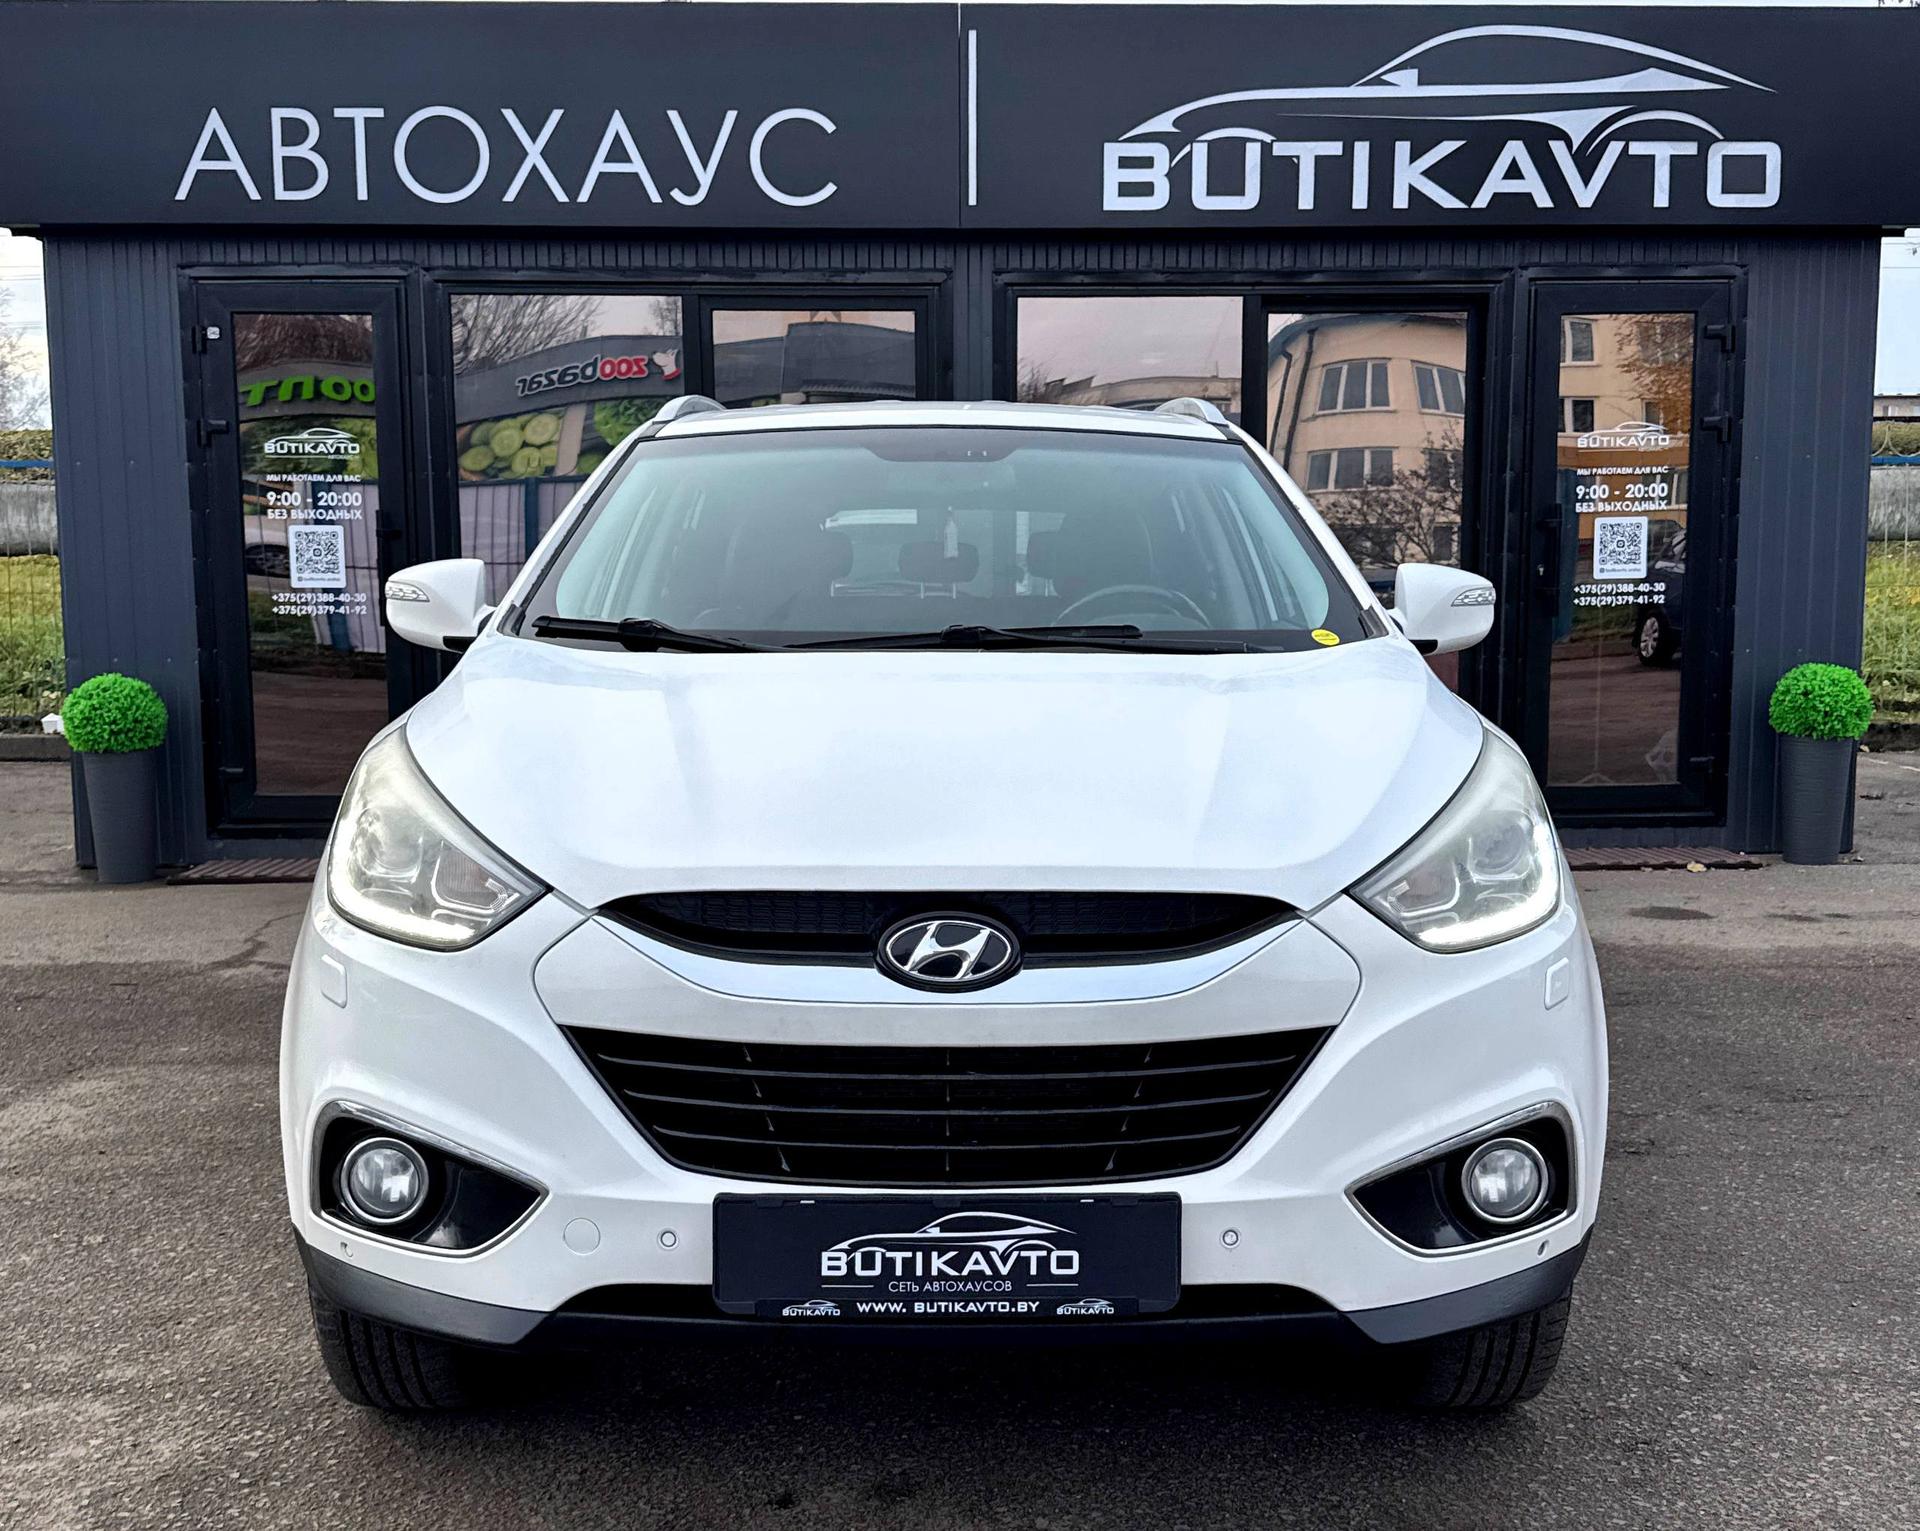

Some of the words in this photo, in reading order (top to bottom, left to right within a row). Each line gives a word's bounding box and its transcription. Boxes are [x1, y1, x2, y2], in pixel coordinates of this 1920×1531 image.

[174, 105, 838, 206] АВТОХАУС
[1102, 139, 1782, 211] BUTIKAVTO
[1577, 435, 1670, 448] BUTIKAVTO
[264, 442, 360, 454] BUTIKAVTO
[1577, 468, 1591, 476] МЫ
[1592, 467, 1633, 476] РАБОТАЕМ
[1634, 467, 1651, 475] ДЛЯ
[1652, 466, 1669, 474] ВАС
[266, 474, 281, 482] МЫ
[282, 474, 325, 482] РАБОТАЕМ
[325, 474, 343, 483] ДЛЯ
[1576, 484, 1609, 499] 9:00
[1625, 483, 1668, 498] 20:00
[266, 491, 301, 506] 9:00
[317, 492, 362, 506] 20:00
[1575, 502, 1595, 513] БЕЗ
[1598, 500, 1668, 512] ВЫХОДНЫХ
[267, 509, 288, 519] БЕЗ
[291, 509, 362, 520] ВЫХОДНЫХ
[1573, 582, 1665, 594] +375(29)388-40-30
[272, 593, 367, 604] +375(29)388-40-30
[1573, 595, 1665, 607] +375(29)379-41-92
[272, 605, 367, 616] +375(29)379-41-92
[821, 1250, 1080, 1276] BUTIKAVTO
[888, 1281, 919, 1293] СЕТЬ
[923, 1280, 1012, 1293] АВТОХАУСОВ
[782, 1307, 841, 1317] BUTIKAVTO
[914, 1301, 1040, 1313] BUTIKAVTO.BY
[1056, 1306, 1114, 1315] BUTIKAVTO
